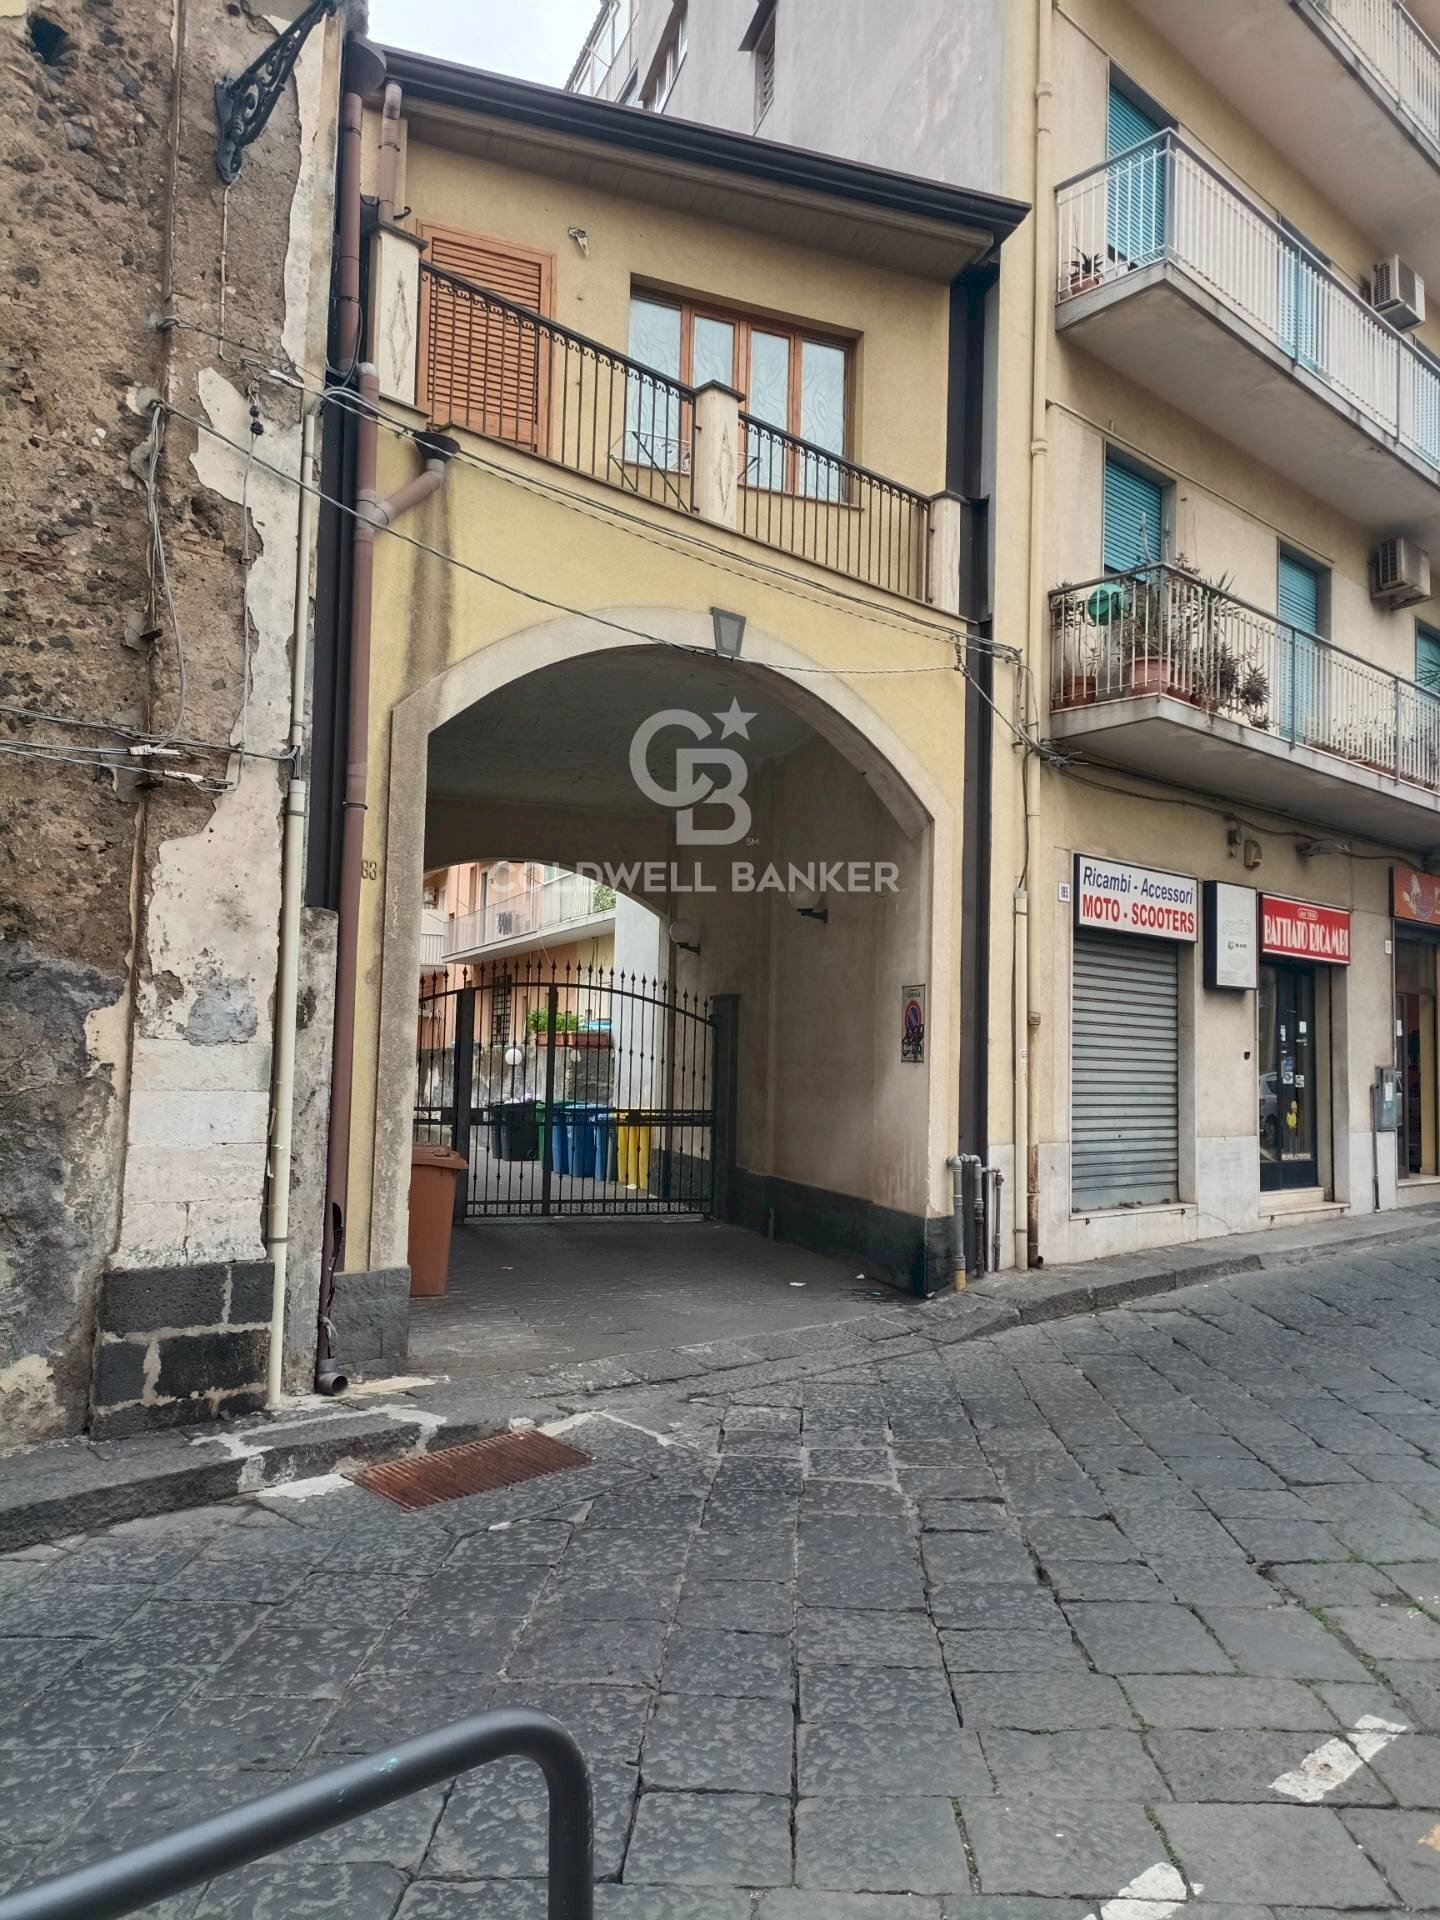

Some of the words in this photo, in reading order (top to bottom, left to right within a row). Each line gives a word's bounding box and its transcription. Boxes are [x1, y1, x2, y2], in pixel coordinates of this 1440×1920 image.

[1083, 866, 1132, 893] Ricambi
[1141, 878, 1193, 905] Accessori
[1082, 894, 1120, 922] MOTO
[1131, 902, 1195, 934] SCOOTERS
[1263, 914, 1309, 950] BATTIATO
[1309, 922, 1349, 957] RICAMBI
